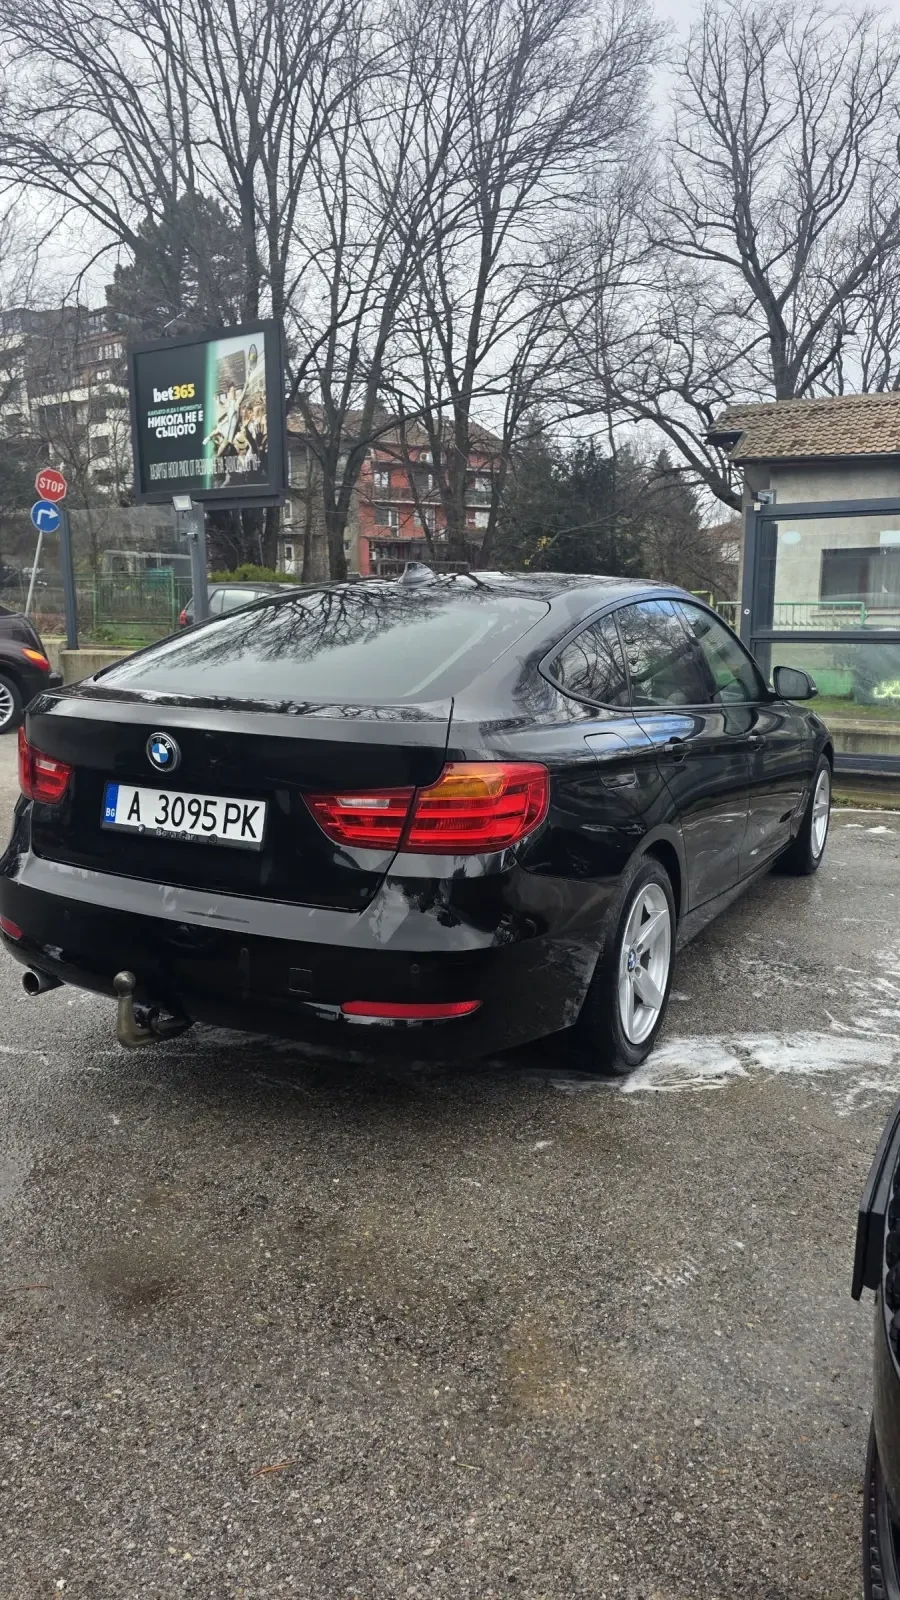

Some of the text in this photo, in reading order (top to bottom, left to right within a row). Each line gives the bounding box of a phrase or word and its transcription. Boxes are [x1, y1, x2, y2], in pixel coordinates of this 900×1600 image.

[153, 383, 195, 403] bet365
[148, 410, 204, 428] НИКОГА НЕ Е
[156, 424, 196, 438] СЪЩОТО
[39, 477, 64, 493] STOP
[105, 808, 115, 818] BG
[127, 791, 260, 838] A 3095 PK
